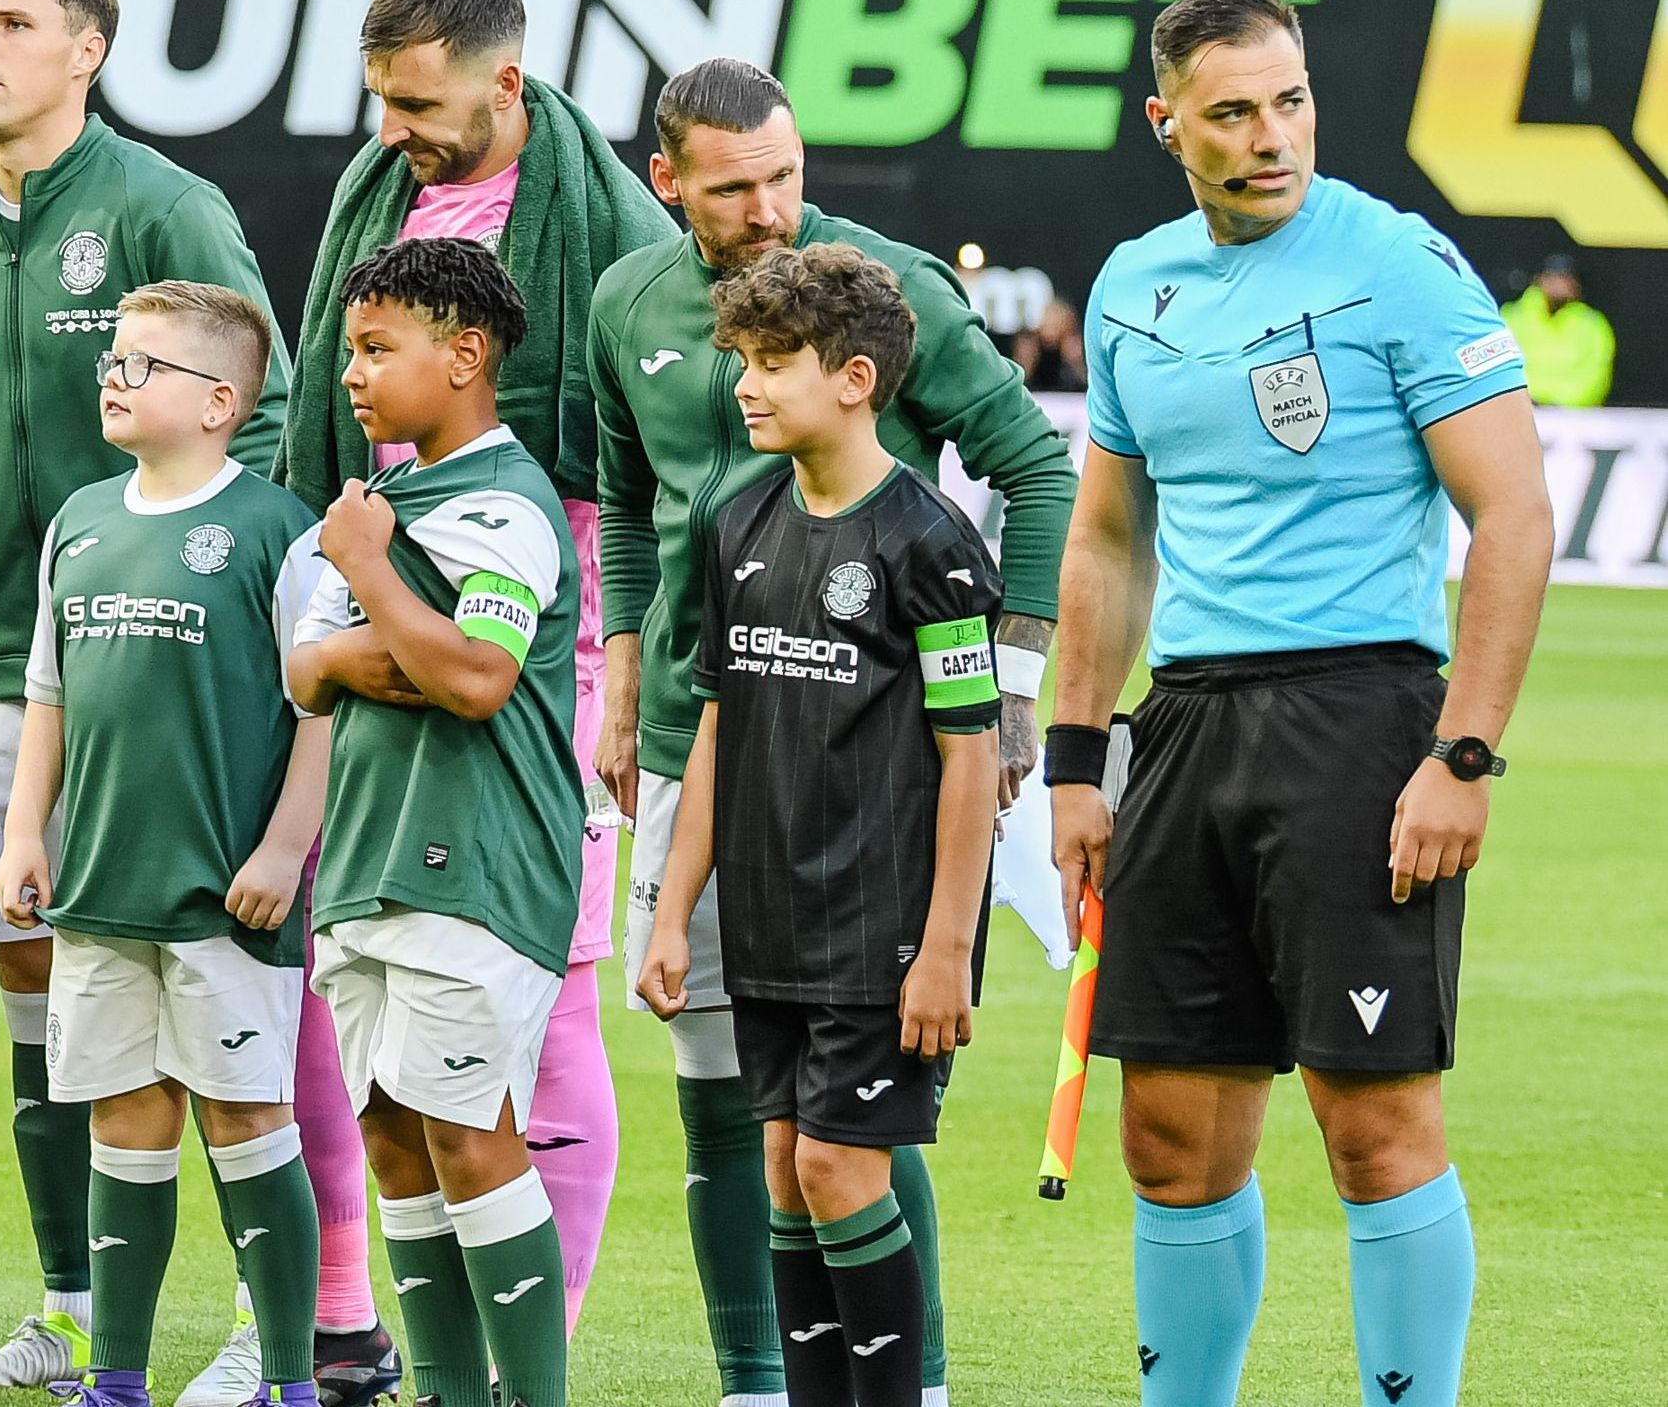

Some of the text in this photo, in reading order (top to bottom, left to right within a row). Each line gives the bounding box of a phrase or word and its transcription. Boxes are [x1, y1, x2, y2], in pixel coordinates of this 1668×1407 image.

[1264, 370, 1305, 391] UEFA
[1272, 395, 1313, 413] MATCH
[1271, 408, 1321, 428] OFFICIAL
[64, 592, 206, 627] G Gibson
[463, 598, 530, 632] CAPTAIN
[66, 622, 205, 645] Joinery & Sons Ltd
[728, 624, 859, 666] G Gibson
[770, 659, 784, 676] &
[784, 662, 825, 680] Sons
[824, 666, 858, 685] Ltd
